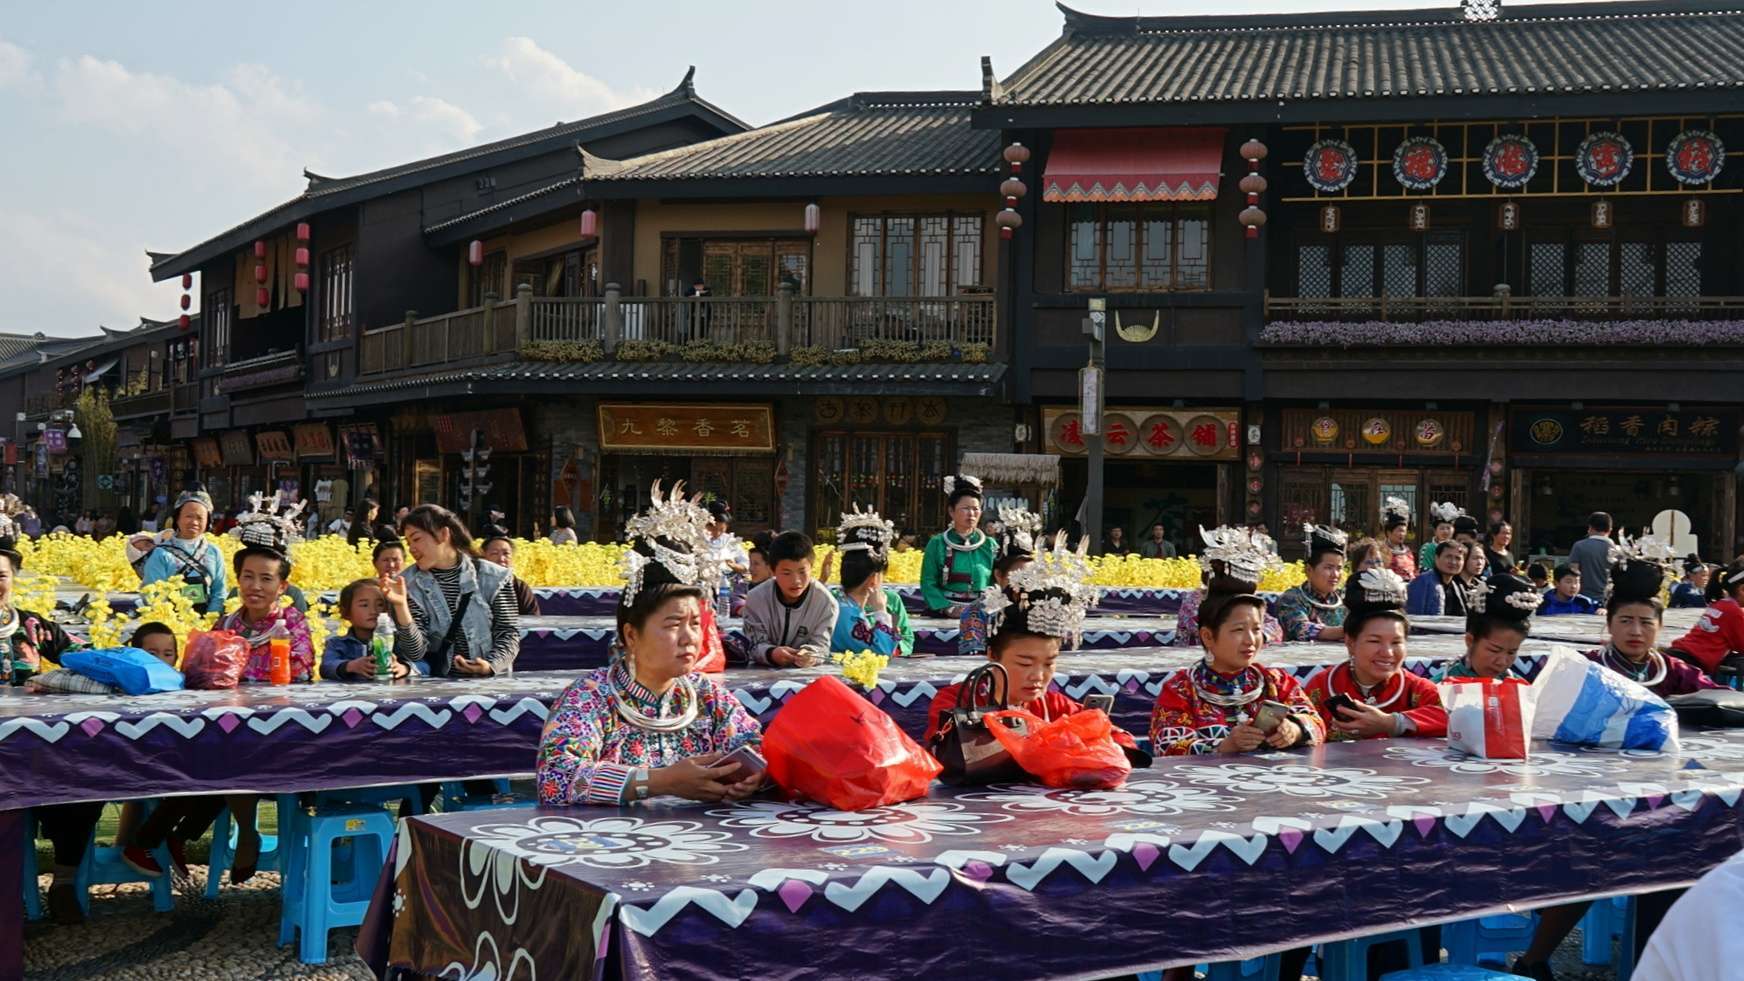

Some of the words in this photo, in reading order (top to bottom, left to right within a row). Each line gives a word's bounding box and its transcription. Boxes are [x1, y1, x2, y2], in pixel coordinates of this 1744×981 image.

[620, 417, 752, 438] 九黎香茗
[1580, 415, 1721, 436] 稻香肉粽
